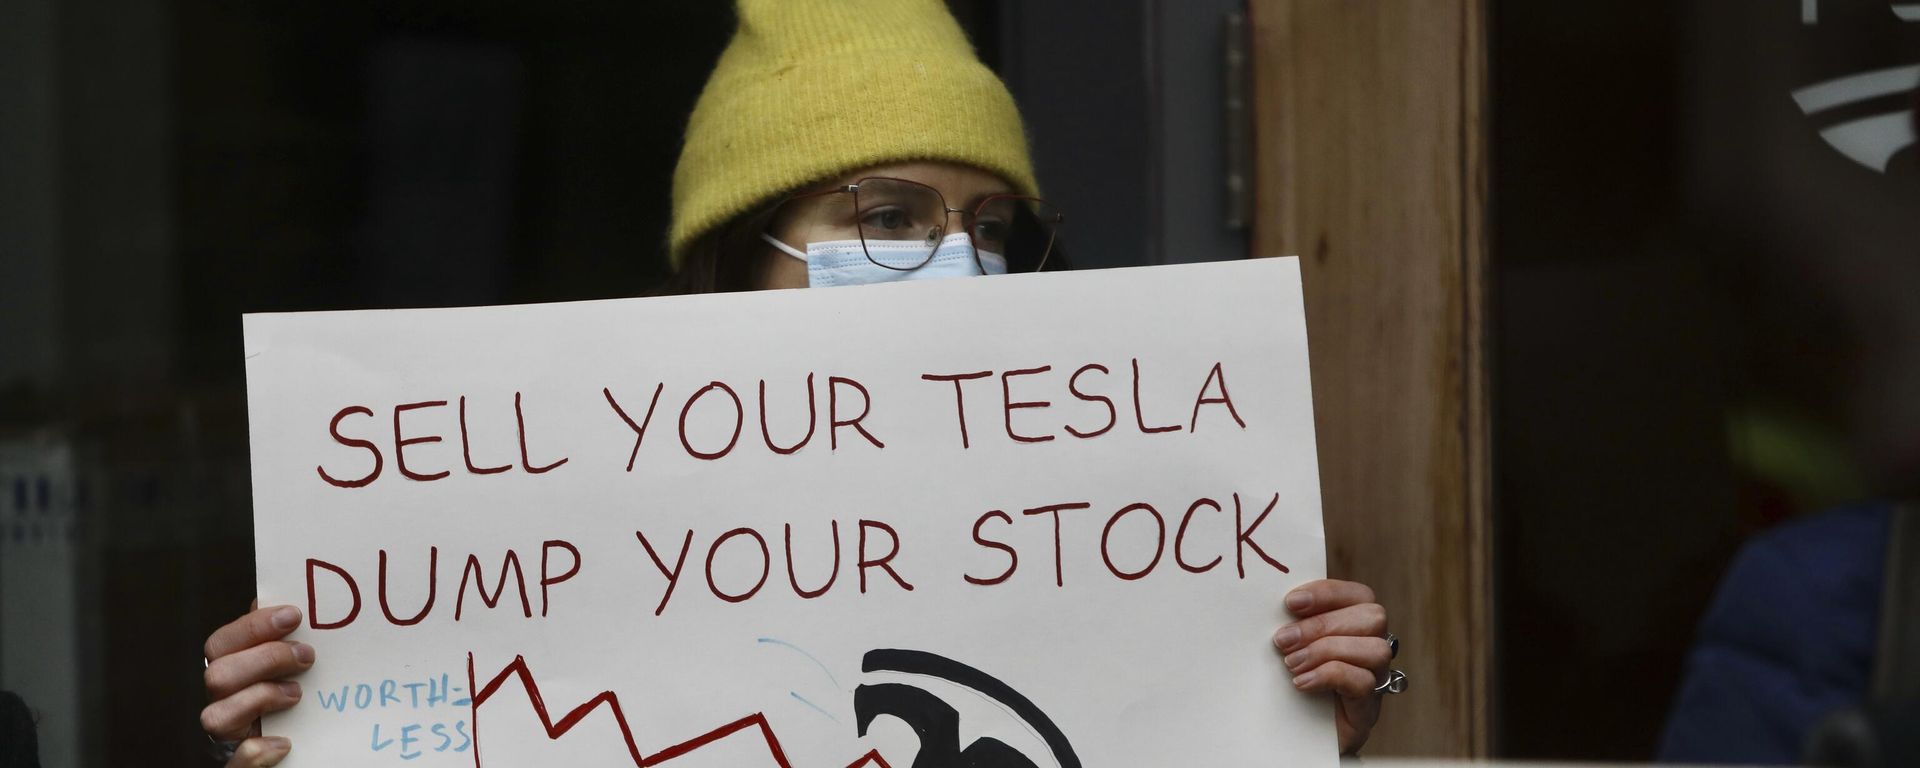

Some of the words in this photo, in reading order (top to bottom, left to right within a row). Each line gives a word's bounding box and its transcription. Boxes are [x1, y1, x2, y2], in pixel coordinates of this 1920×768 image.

[316, 392, 569, 488] SELL
[603, 373, 886, 472] YOUR
[921, 358, 1246, 449] TESLA
[305, 540, 581, 630] DUMP
[636, 519, 913, 617] YOUR
[964, 493, 1290, 587] STOCK
[370, 720, 471, 760] LESS
